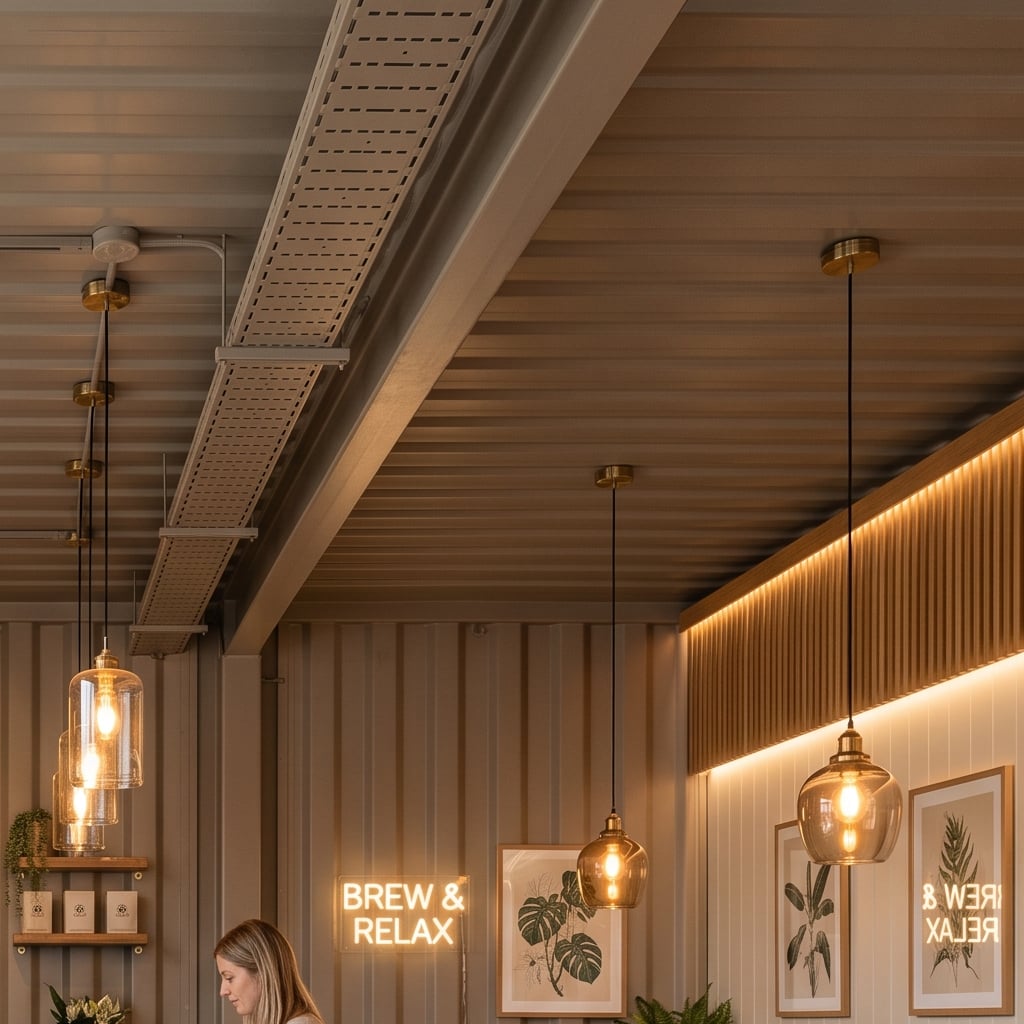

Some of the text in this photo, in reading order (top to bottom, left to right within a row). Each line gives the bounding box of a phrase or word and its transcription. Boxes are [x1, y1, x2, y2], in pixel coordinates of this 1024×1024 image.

[343, 883, 465, 910] BREW &
[354, 917, 454, 945] RELAX
